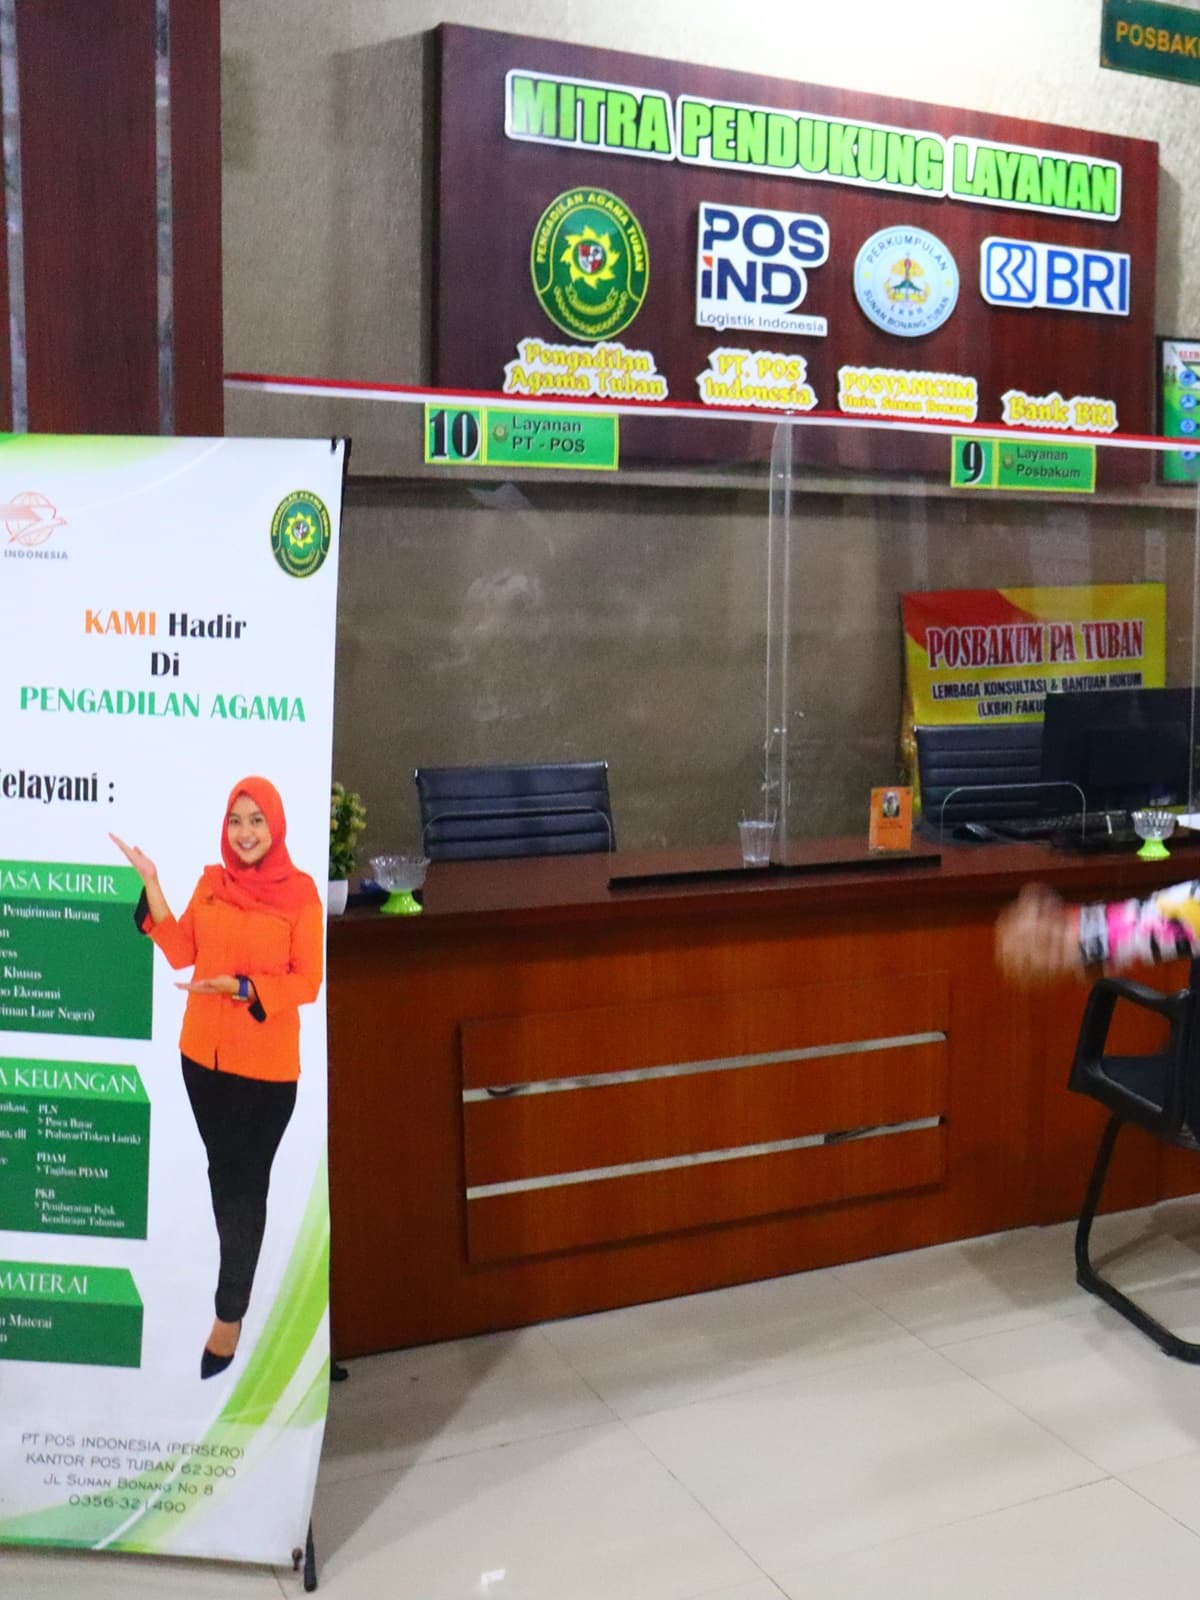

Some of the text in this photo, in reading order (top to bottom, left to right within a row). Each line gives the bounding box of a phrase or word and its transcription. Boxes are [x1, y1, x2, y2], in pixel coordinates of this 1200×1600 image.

[511, 75, 1118, 216] MITRA PENDUKUNG LAYANAN
[587, 192, 630, 226] AGAMA
[627, 224, 645, 273] TUBAN
[702, 207, 826, 262] POS
[866, 234, 949, 271] PERKUMPULAN
[1045, 253, 1130, 315] BRI
[699, 311, 825, 333] Logistik Indonesia
[524, 342, 650, 374] Pengadilan
[756, 356, 801, 380] POS
[508, 365, 665, 396] Agama Tuban
[704, 376, 812, 405] Indonesia
[512, 415, 582, 434] Layanan
[1006, 396, 1115, 428] Bank BRI
[429, 409, 480, 460] 10
[512, 436, 533, 450] PT
[550, 438, 586, 453] POS
[962, 440, 986, 485] 9
[1016, 447, 1069, 465] Layanan
[1016, 463, 1081, 479] Posbakum
[4, 549, 69, 561] INDONESIA
[84, 608, 248, 639] KAMI Hadir
[926, 620, 1145, 669] POSBAKUM PA TUBAN
[150, 651, 180, 677] Di
[932, 683, 981, 700] LEMBAGA
[983, 678, 1047, 697] KONSULTASI
[1061, 676, 1107, 692] BANTUAN
[19, 685, 307, 722] PENGADILAN AGAMA
[1015, 700, 1045, 714] FAKU
[0, 768, 98, 804] elayani
[48, 871, 118, 895] KURIR
[15, 1067, 138, 1095] KEUANGAN
[36, 1151, 67, 1164] PDAM
[78, 1167, 109, 1179] PDAM
[9, 1313, 53, 1329] Materai
[21, 1431, 245, 1460] PT POS INDONESIA (PERSERO)
[26, 1452, 237, 1479] KANTOR POS TUBAN 62300
